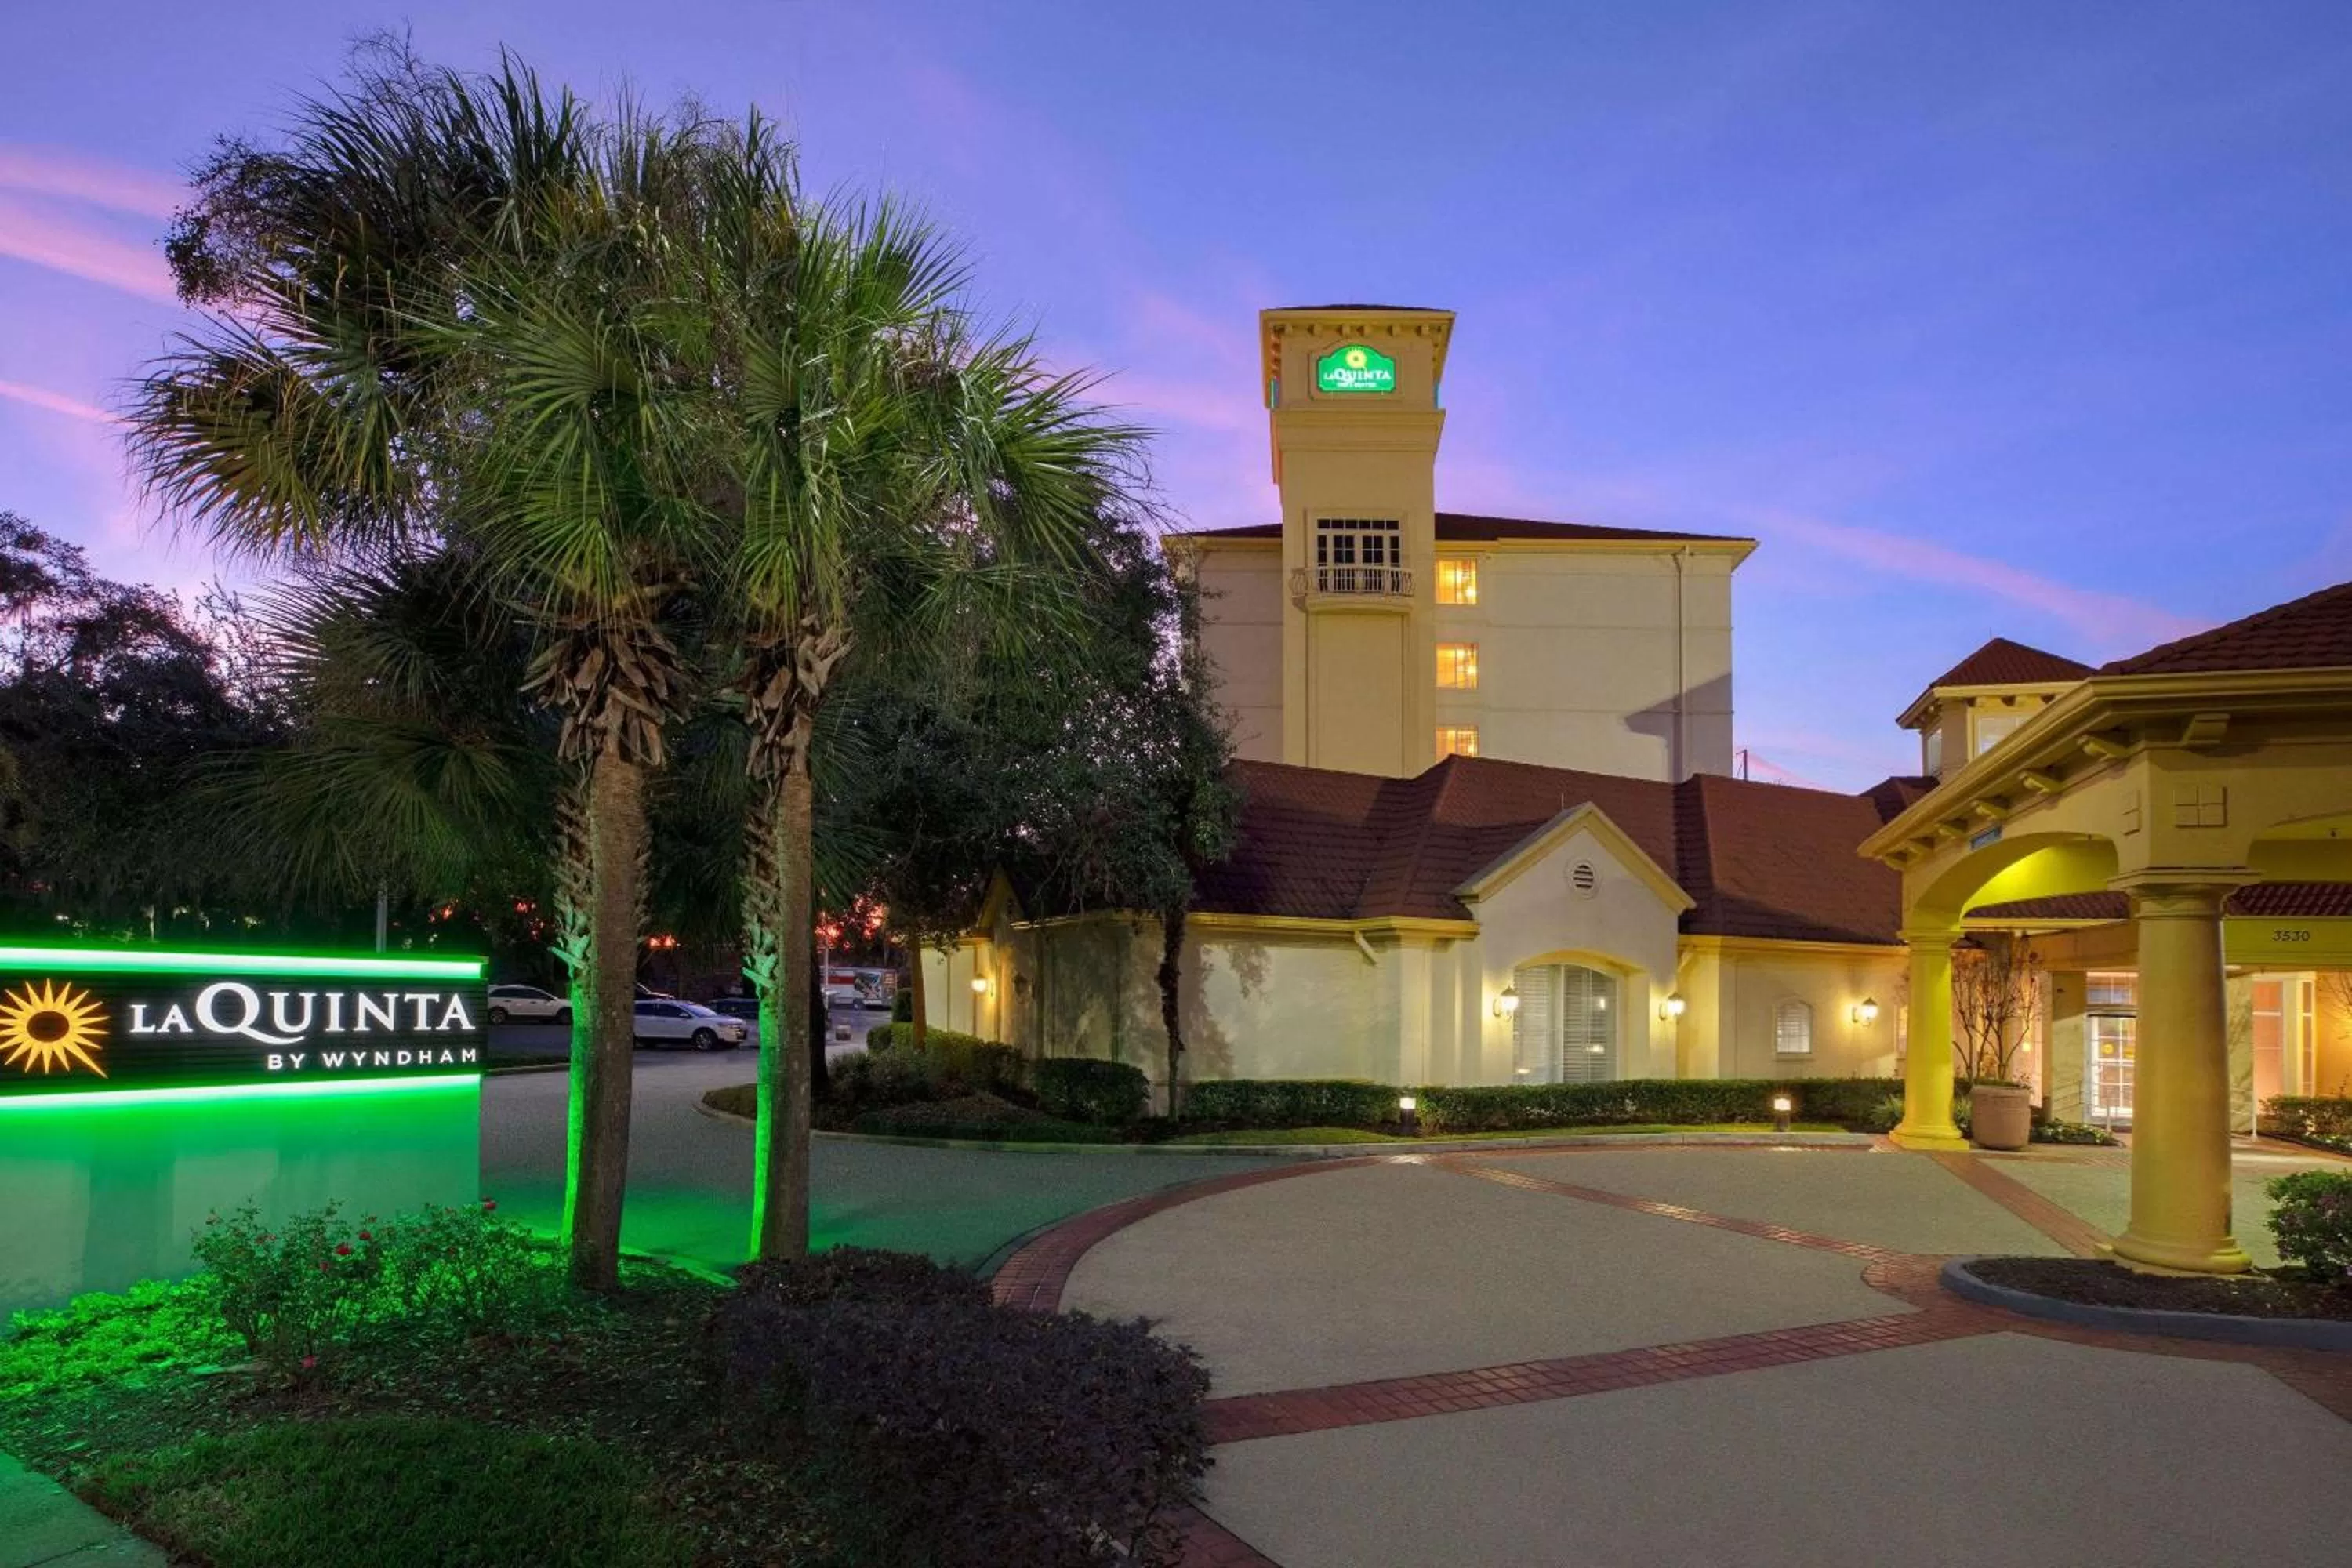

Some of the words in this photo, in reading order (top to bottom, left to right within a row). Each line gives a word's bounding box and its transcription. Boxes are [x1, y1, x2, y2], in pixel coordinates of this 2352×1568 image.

[1334, 368, 1392, 382] QUINTA
[2272, 931, 2310, 942] 3530
[129, 1003, 194, 1034] LA
[194, 982, 476, 1045] QUINTA
[267, 1053, 306, 1070] BY
[322, 1048, 477, 1069] WYNDHAM
